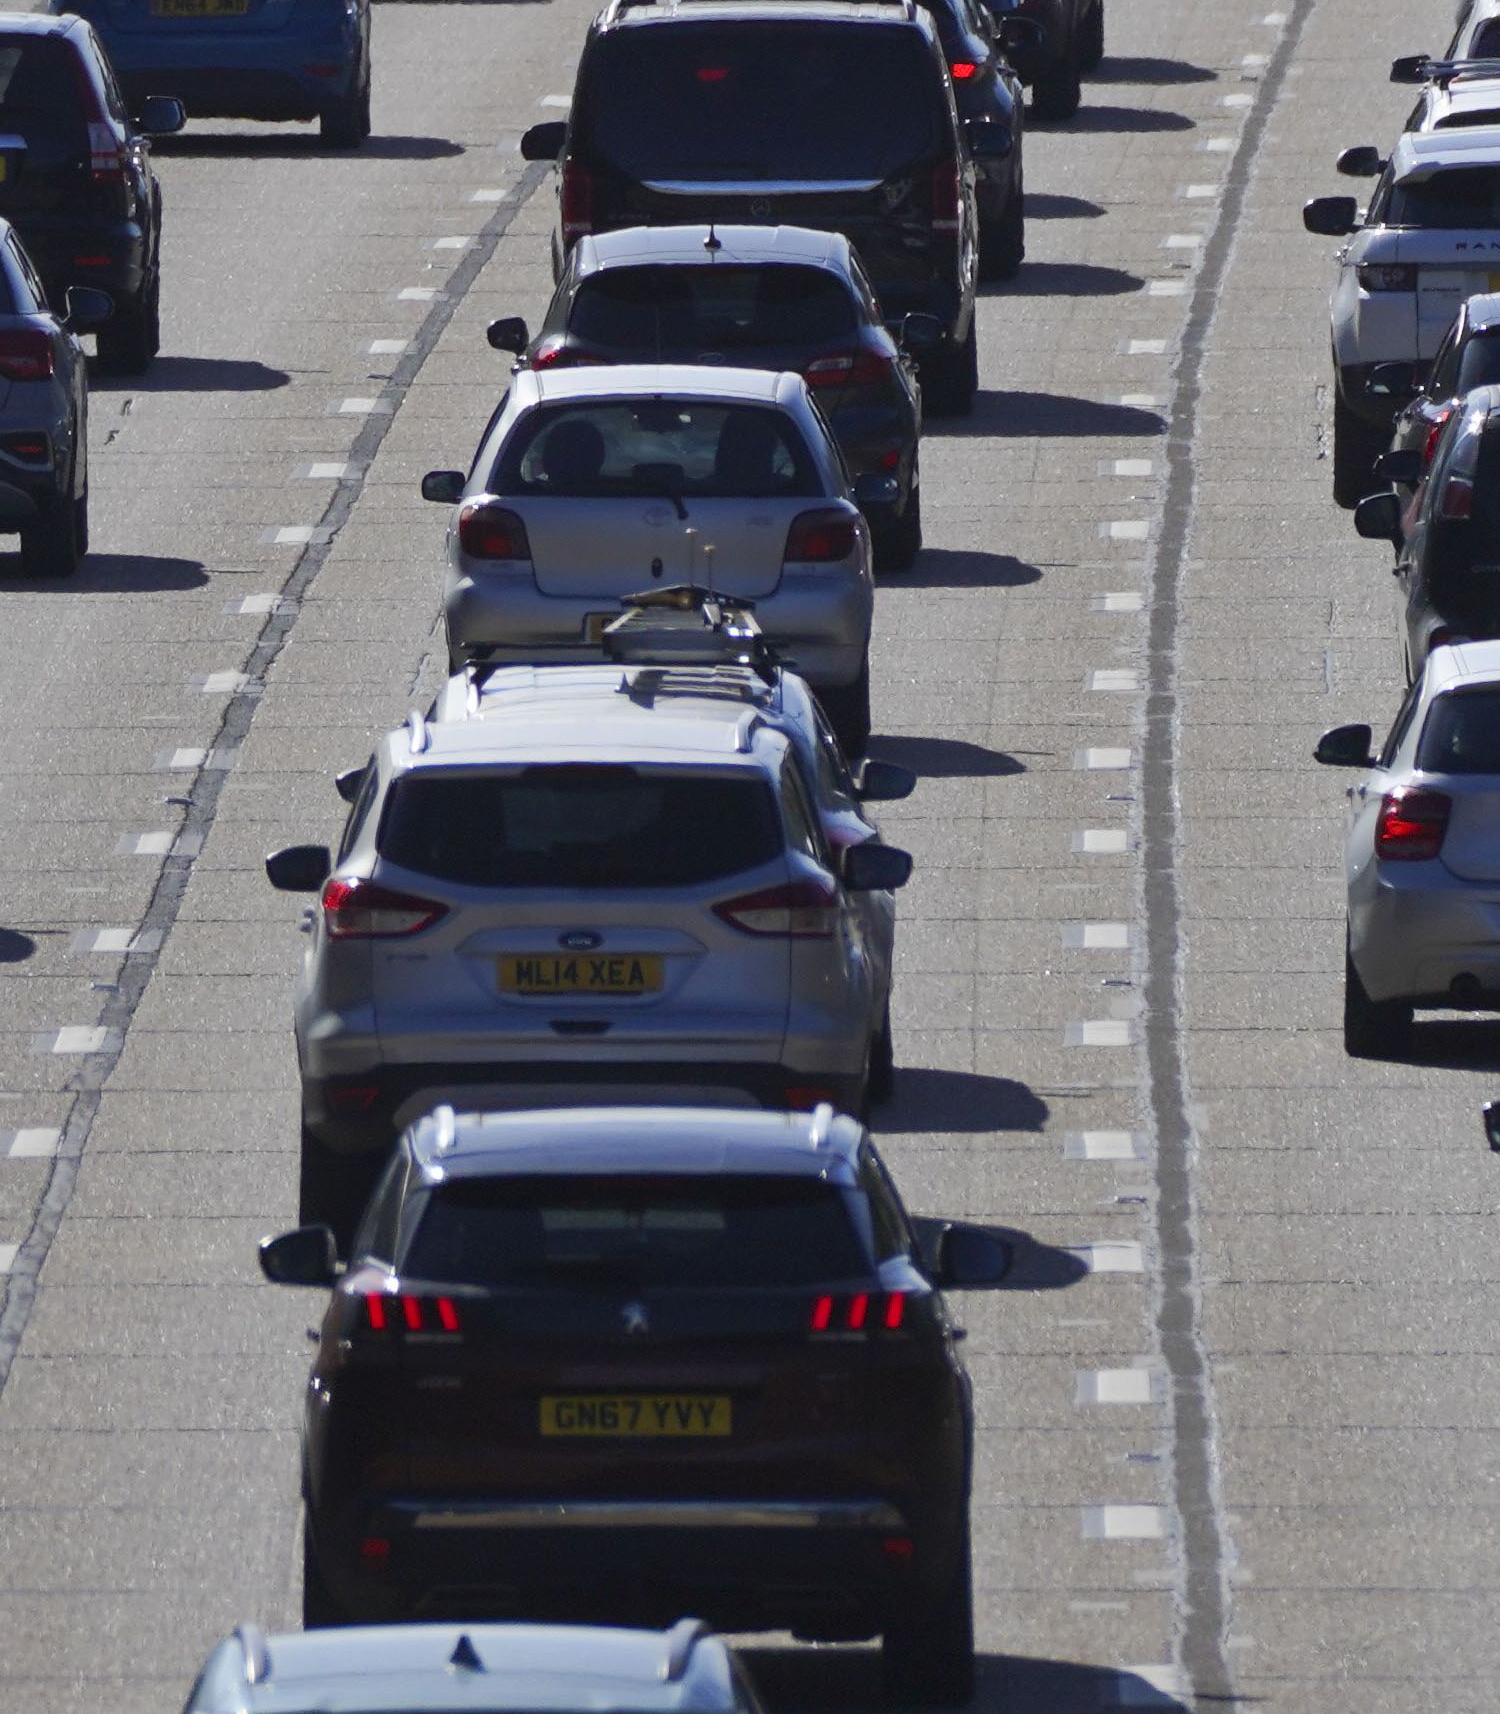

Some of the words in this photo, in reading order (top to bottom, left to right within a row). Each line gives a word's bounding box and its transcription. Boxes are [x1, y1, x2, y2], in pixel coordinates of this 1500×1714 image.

[516, 960, 578, 987] ML14
[588, 960, 645, 986] XEA
[554, 1401, 641, 1429] GN67
[647, 1401, 717, 1428] YVY
